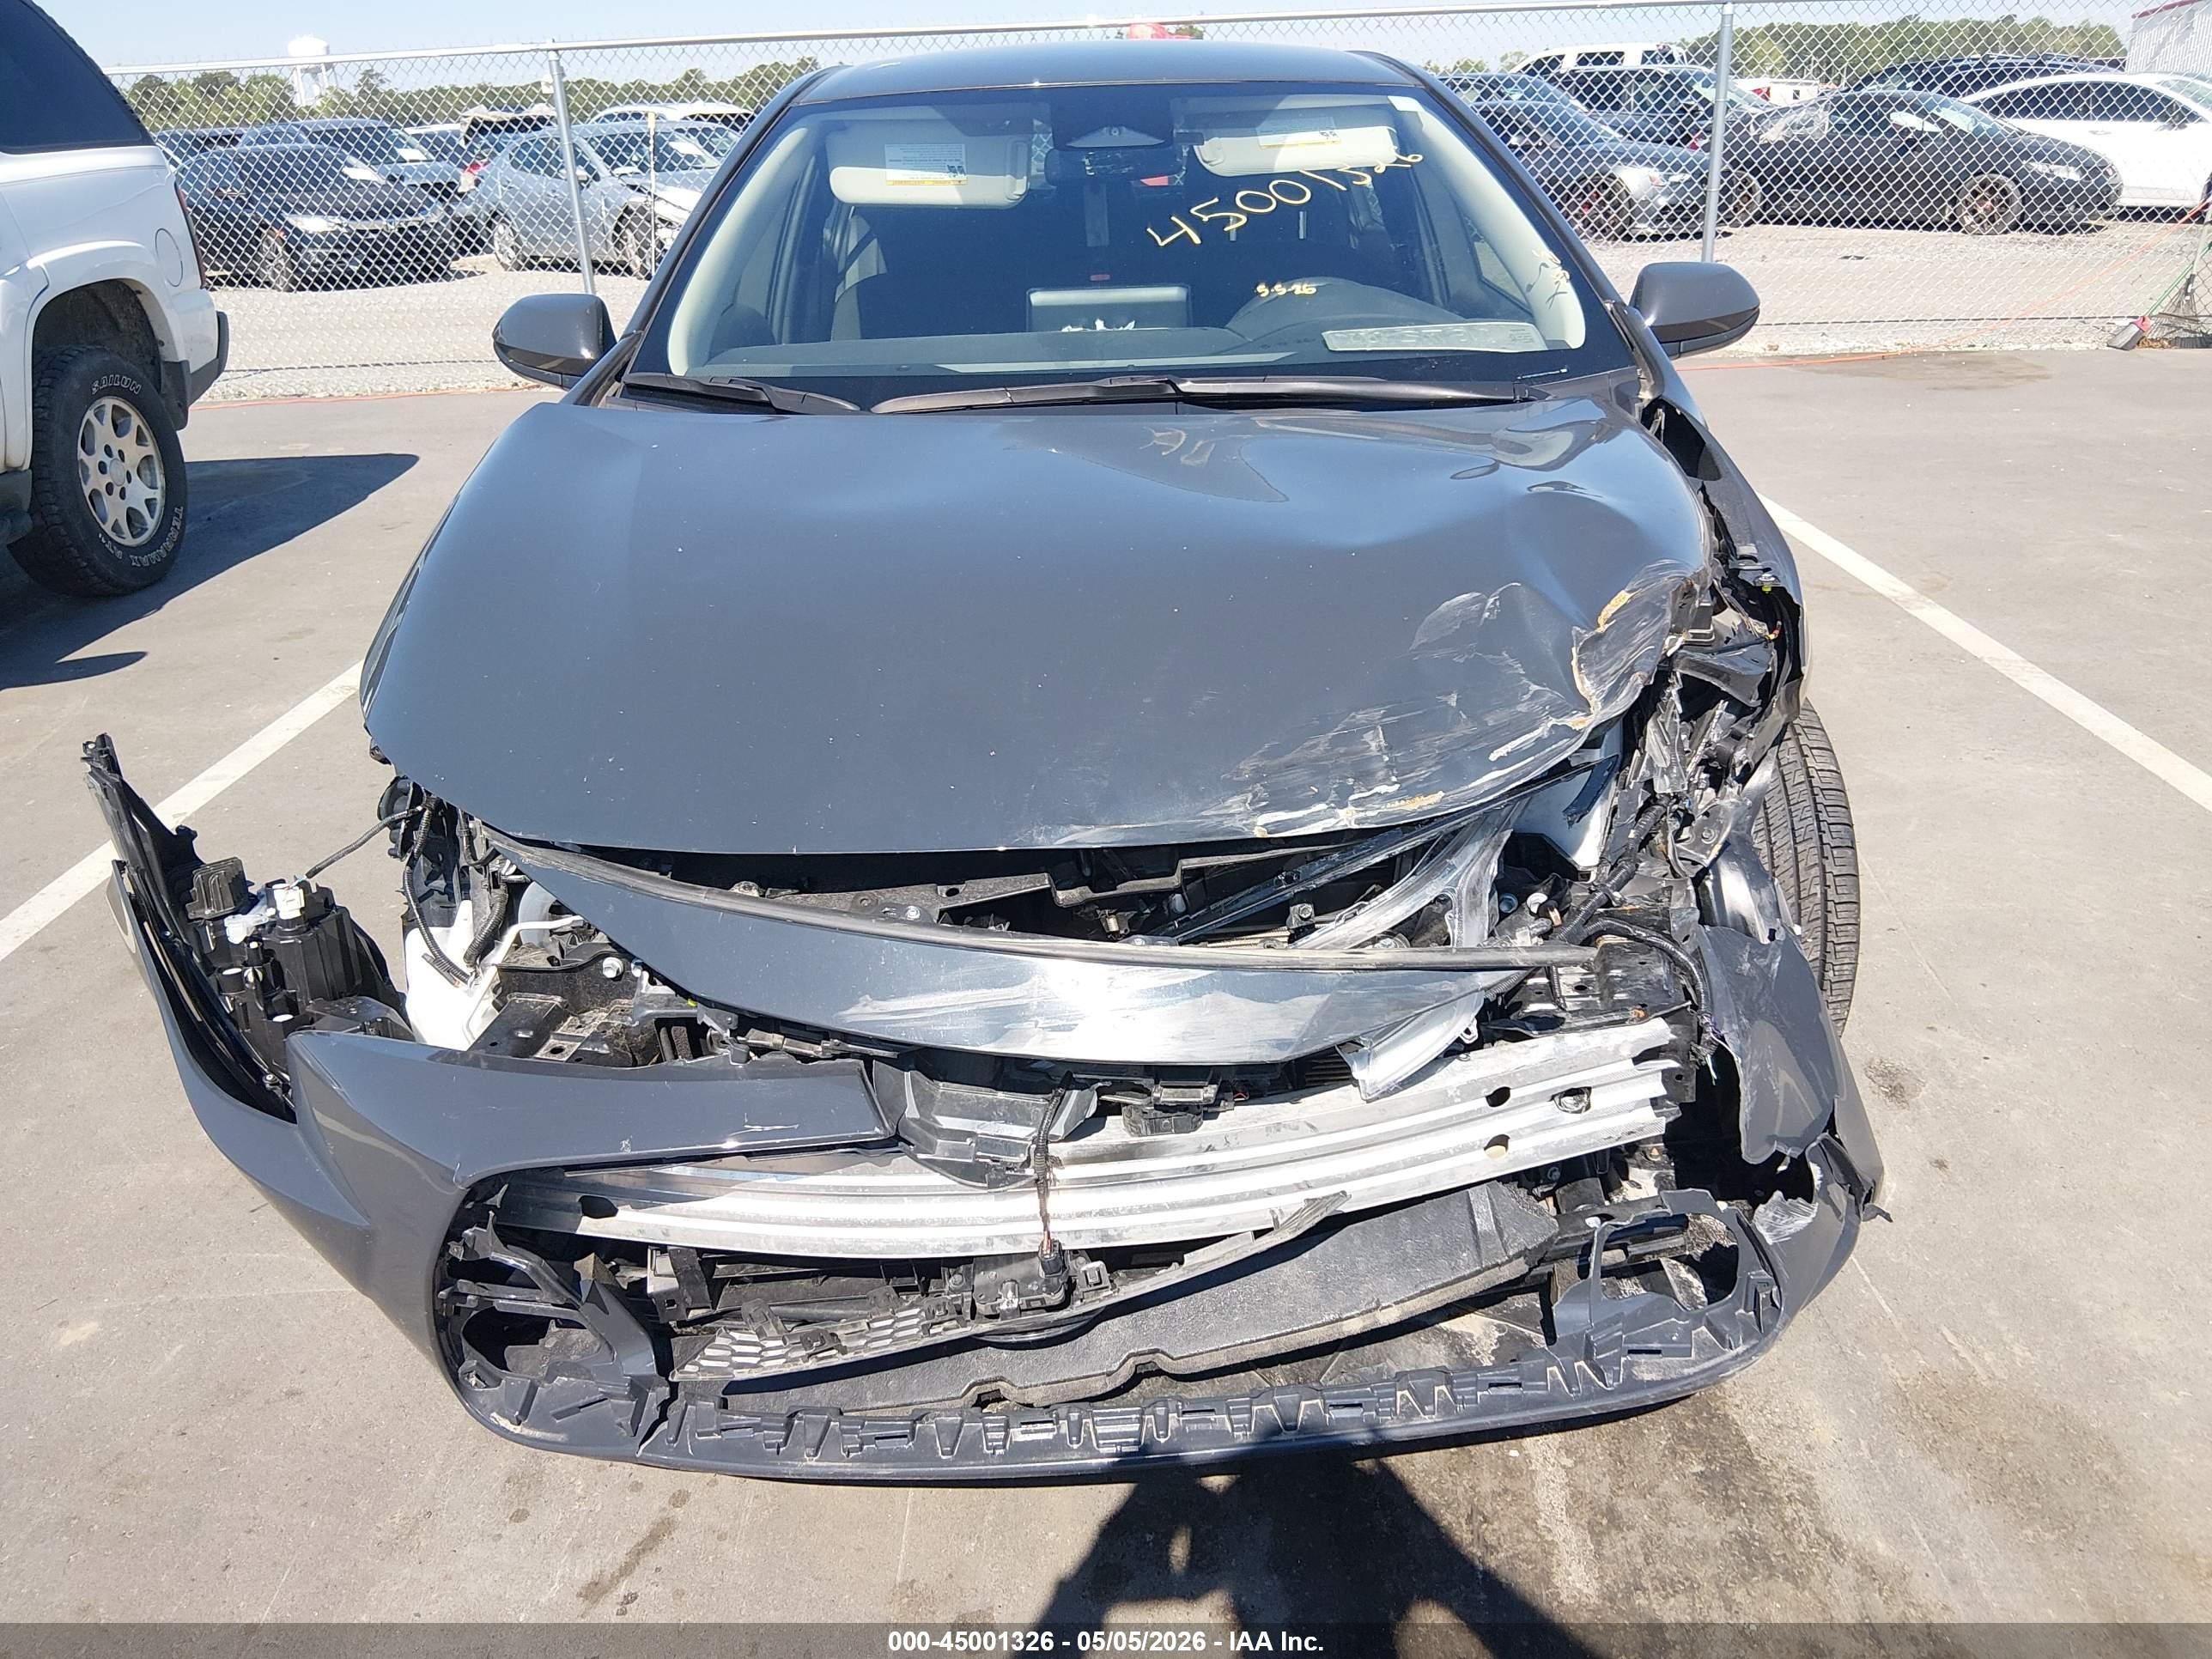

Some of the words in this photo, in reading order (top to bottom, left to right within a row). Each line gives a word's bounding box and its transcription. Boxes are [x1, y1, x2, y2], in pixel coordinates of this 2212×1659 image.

[1146, 145, 1424, 246] 45001326
[91, 374, 142, 394] SAILUN
[130, 506, 184, 567] TERRAMAX
